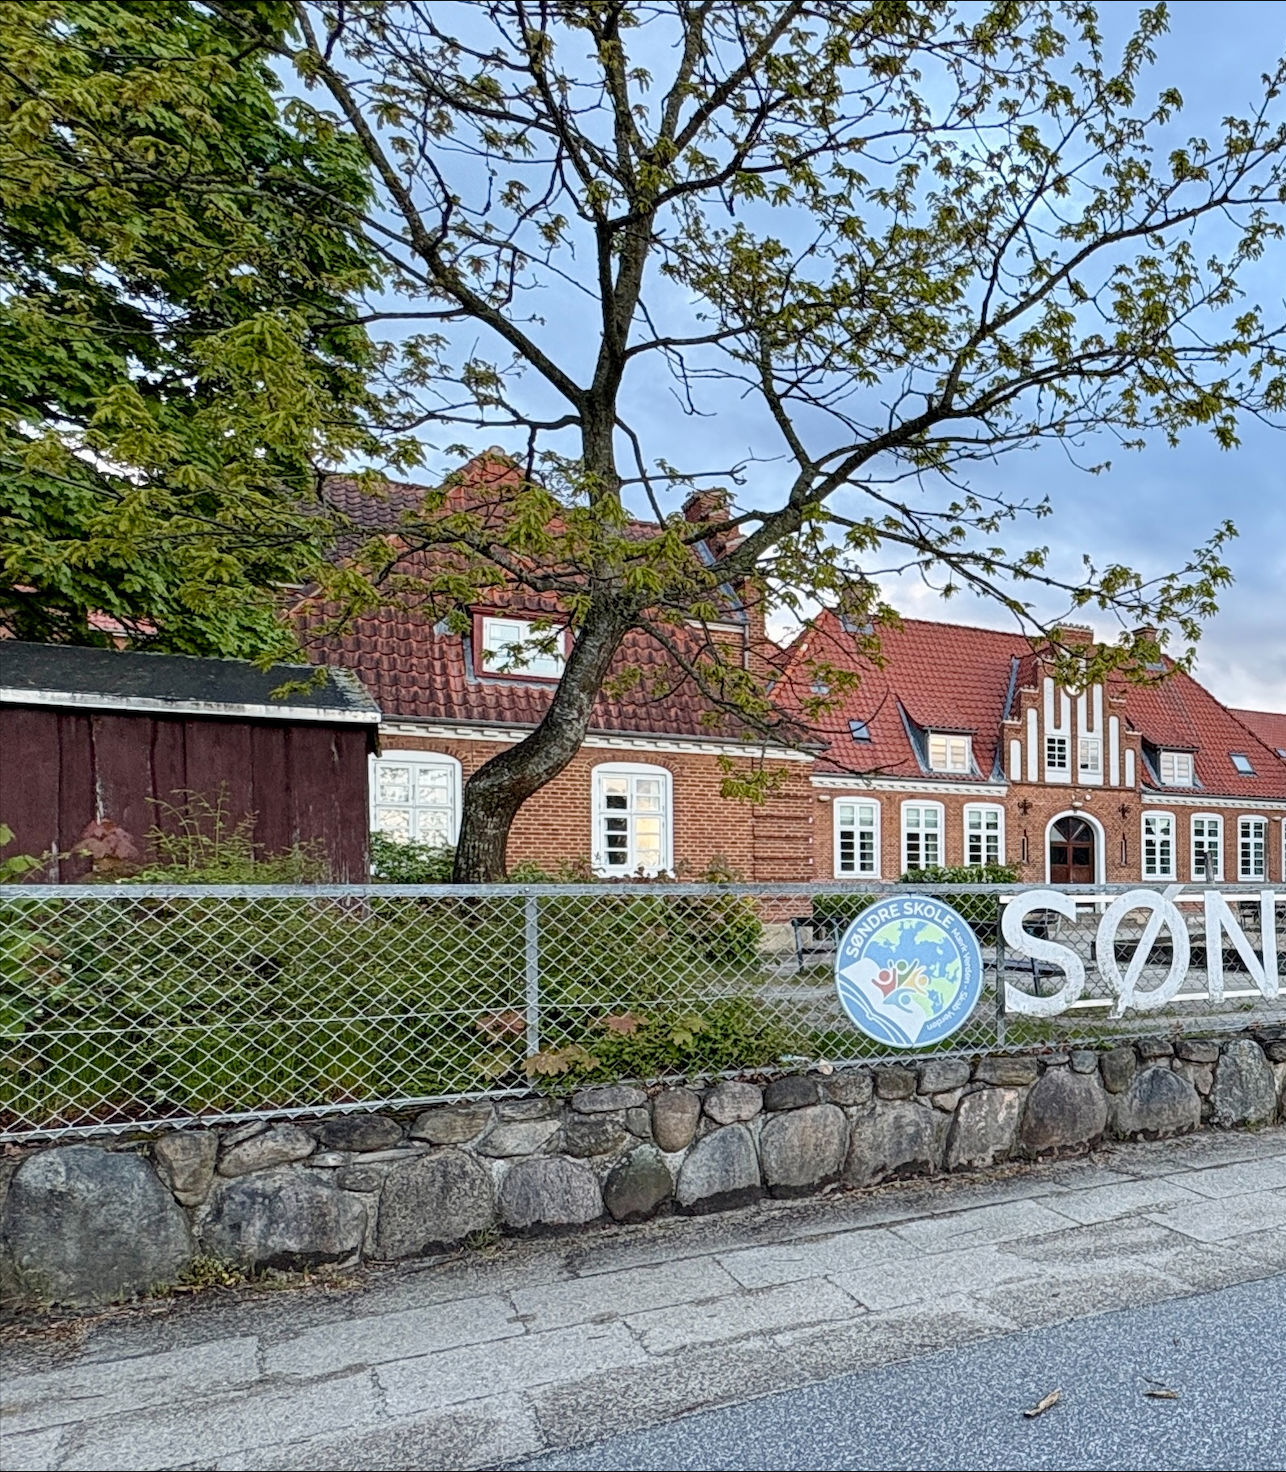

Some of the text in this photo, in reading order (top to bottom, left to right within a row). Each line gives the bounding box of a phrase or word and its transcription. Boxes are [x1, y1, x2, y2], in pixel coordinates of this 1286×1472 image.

[845, 901, 955, 958] SØNDRE SKOLE
[963, 952, 972, 984] Verden
[951, 990, 968, 1011] Skab
[926, 1011, 956, 1031] Verden
